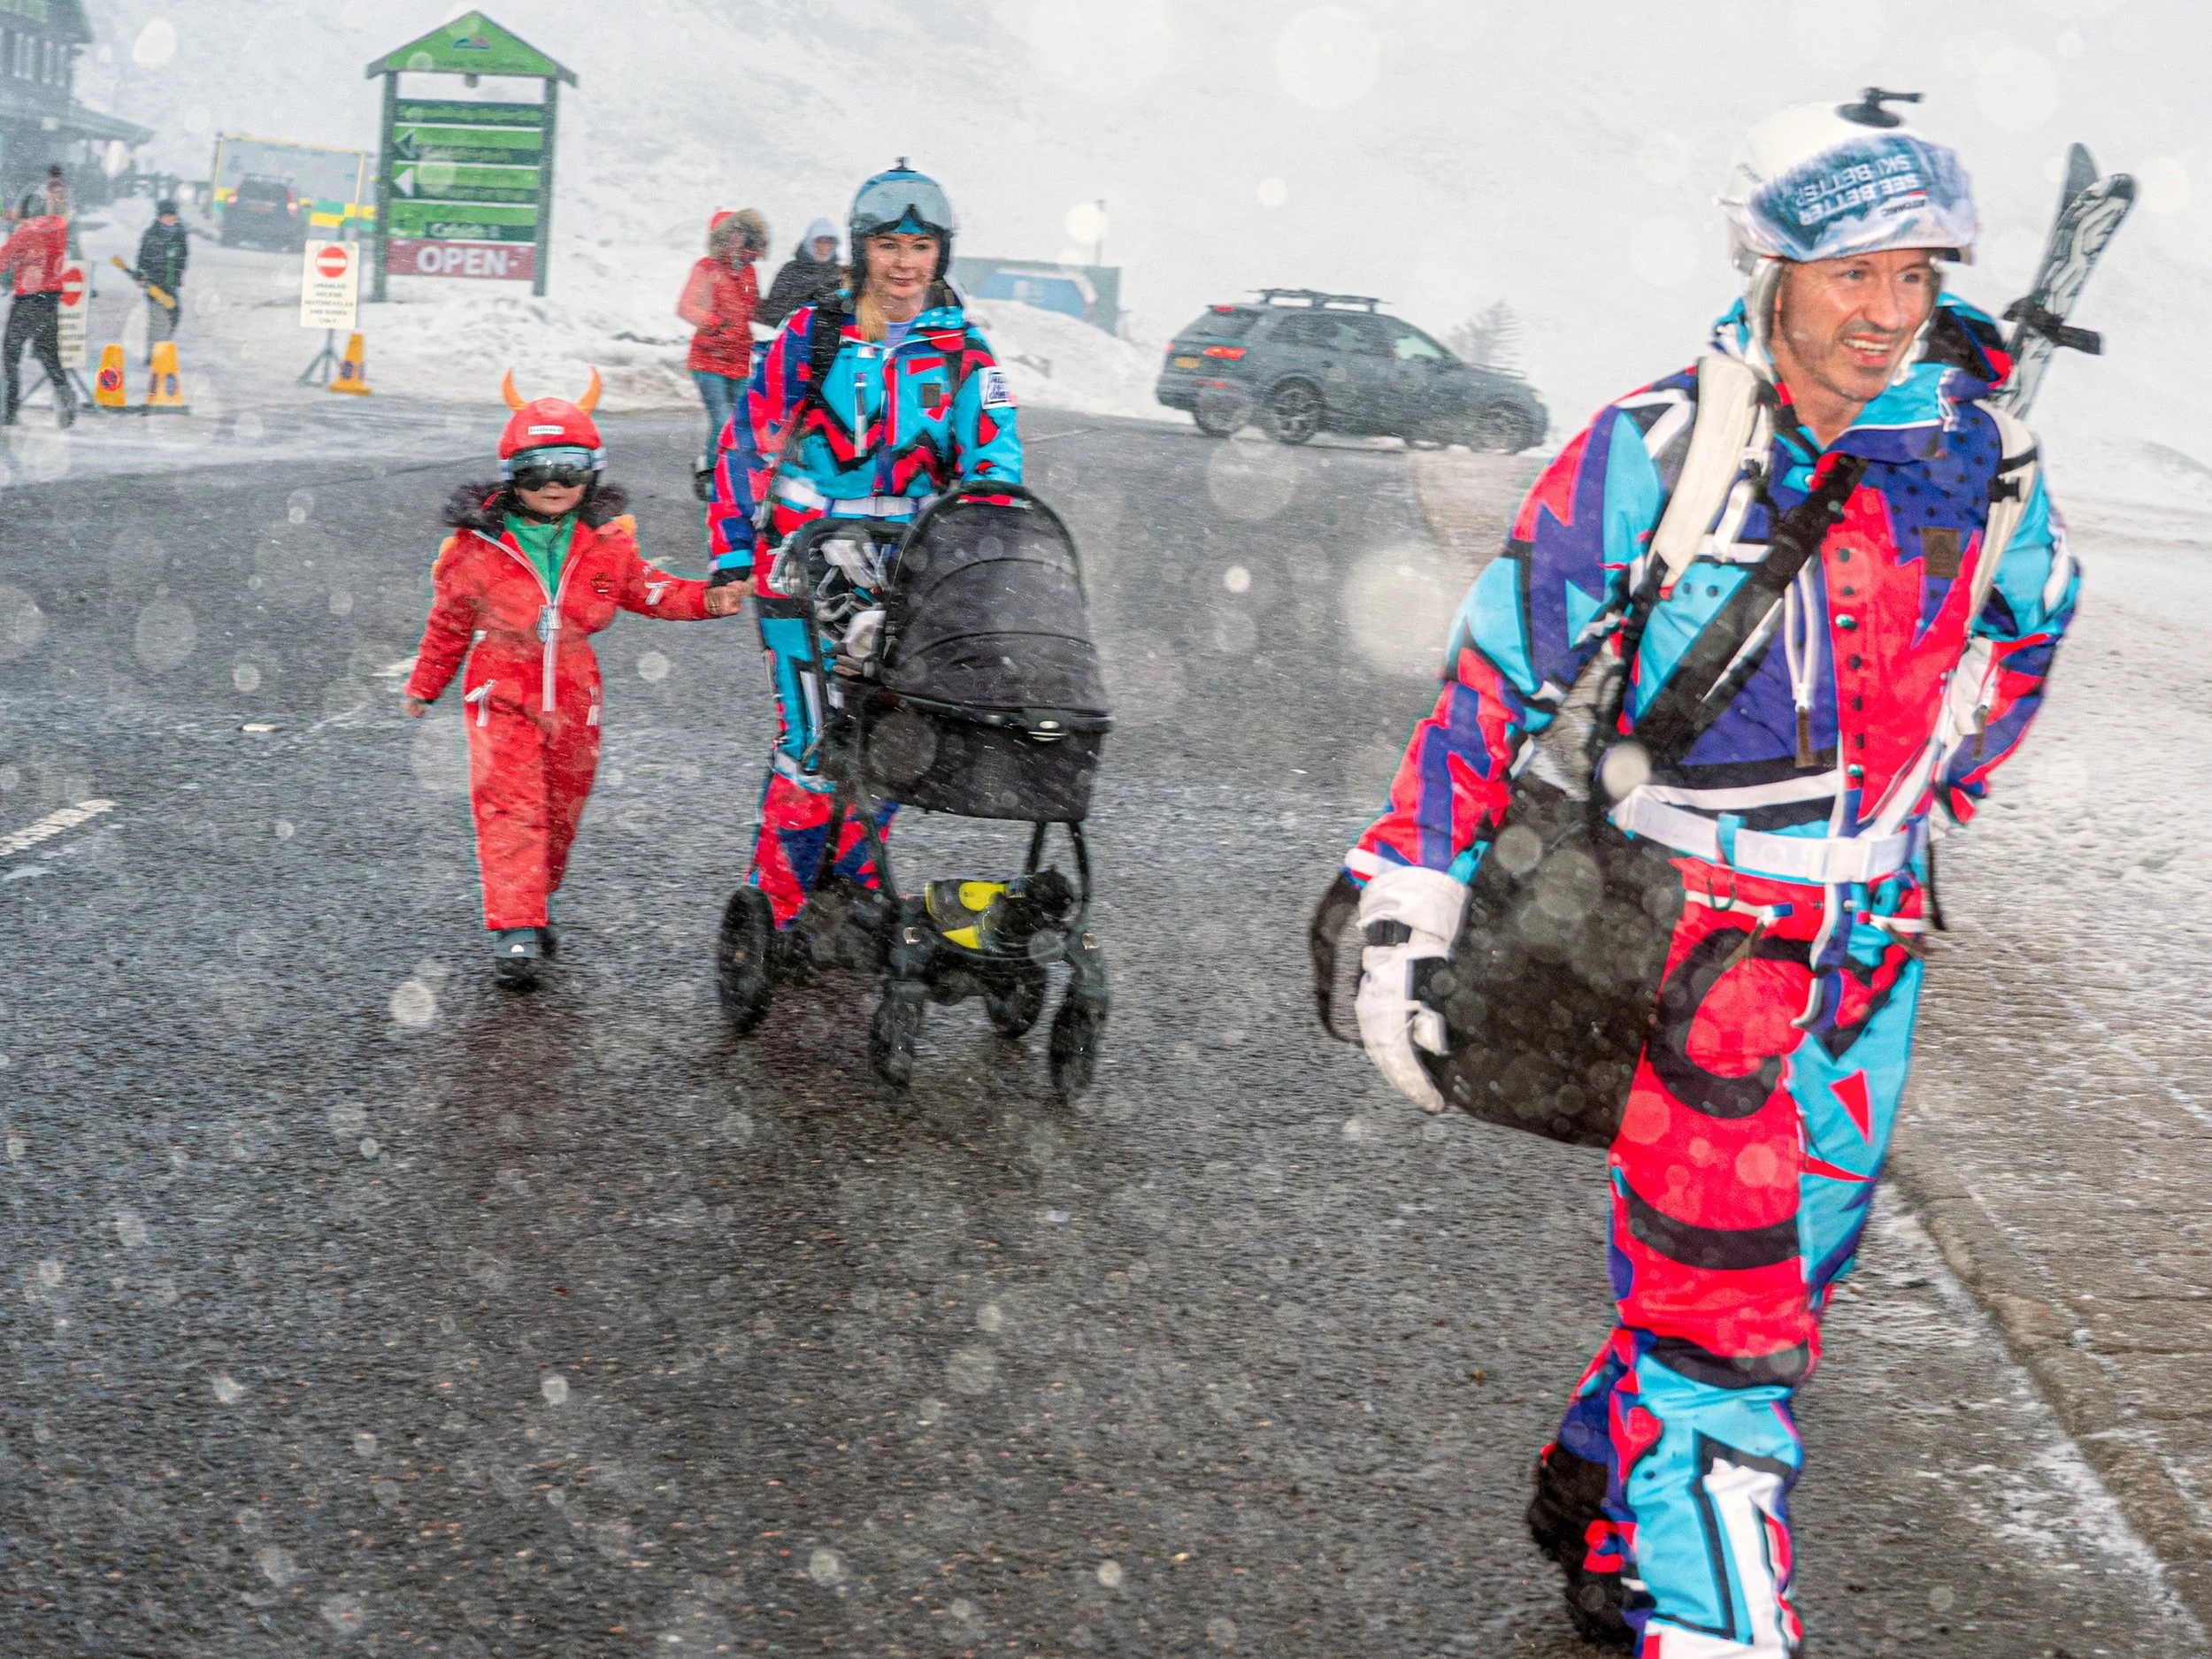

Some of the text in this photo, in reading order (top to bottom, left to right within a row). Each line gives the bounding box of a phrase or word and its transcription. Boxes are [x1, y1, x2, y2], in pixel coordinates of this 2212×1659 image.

[1877, 154, 1911, 175] SKI
[1798, 173, 1920, 226] SEE BETTER
